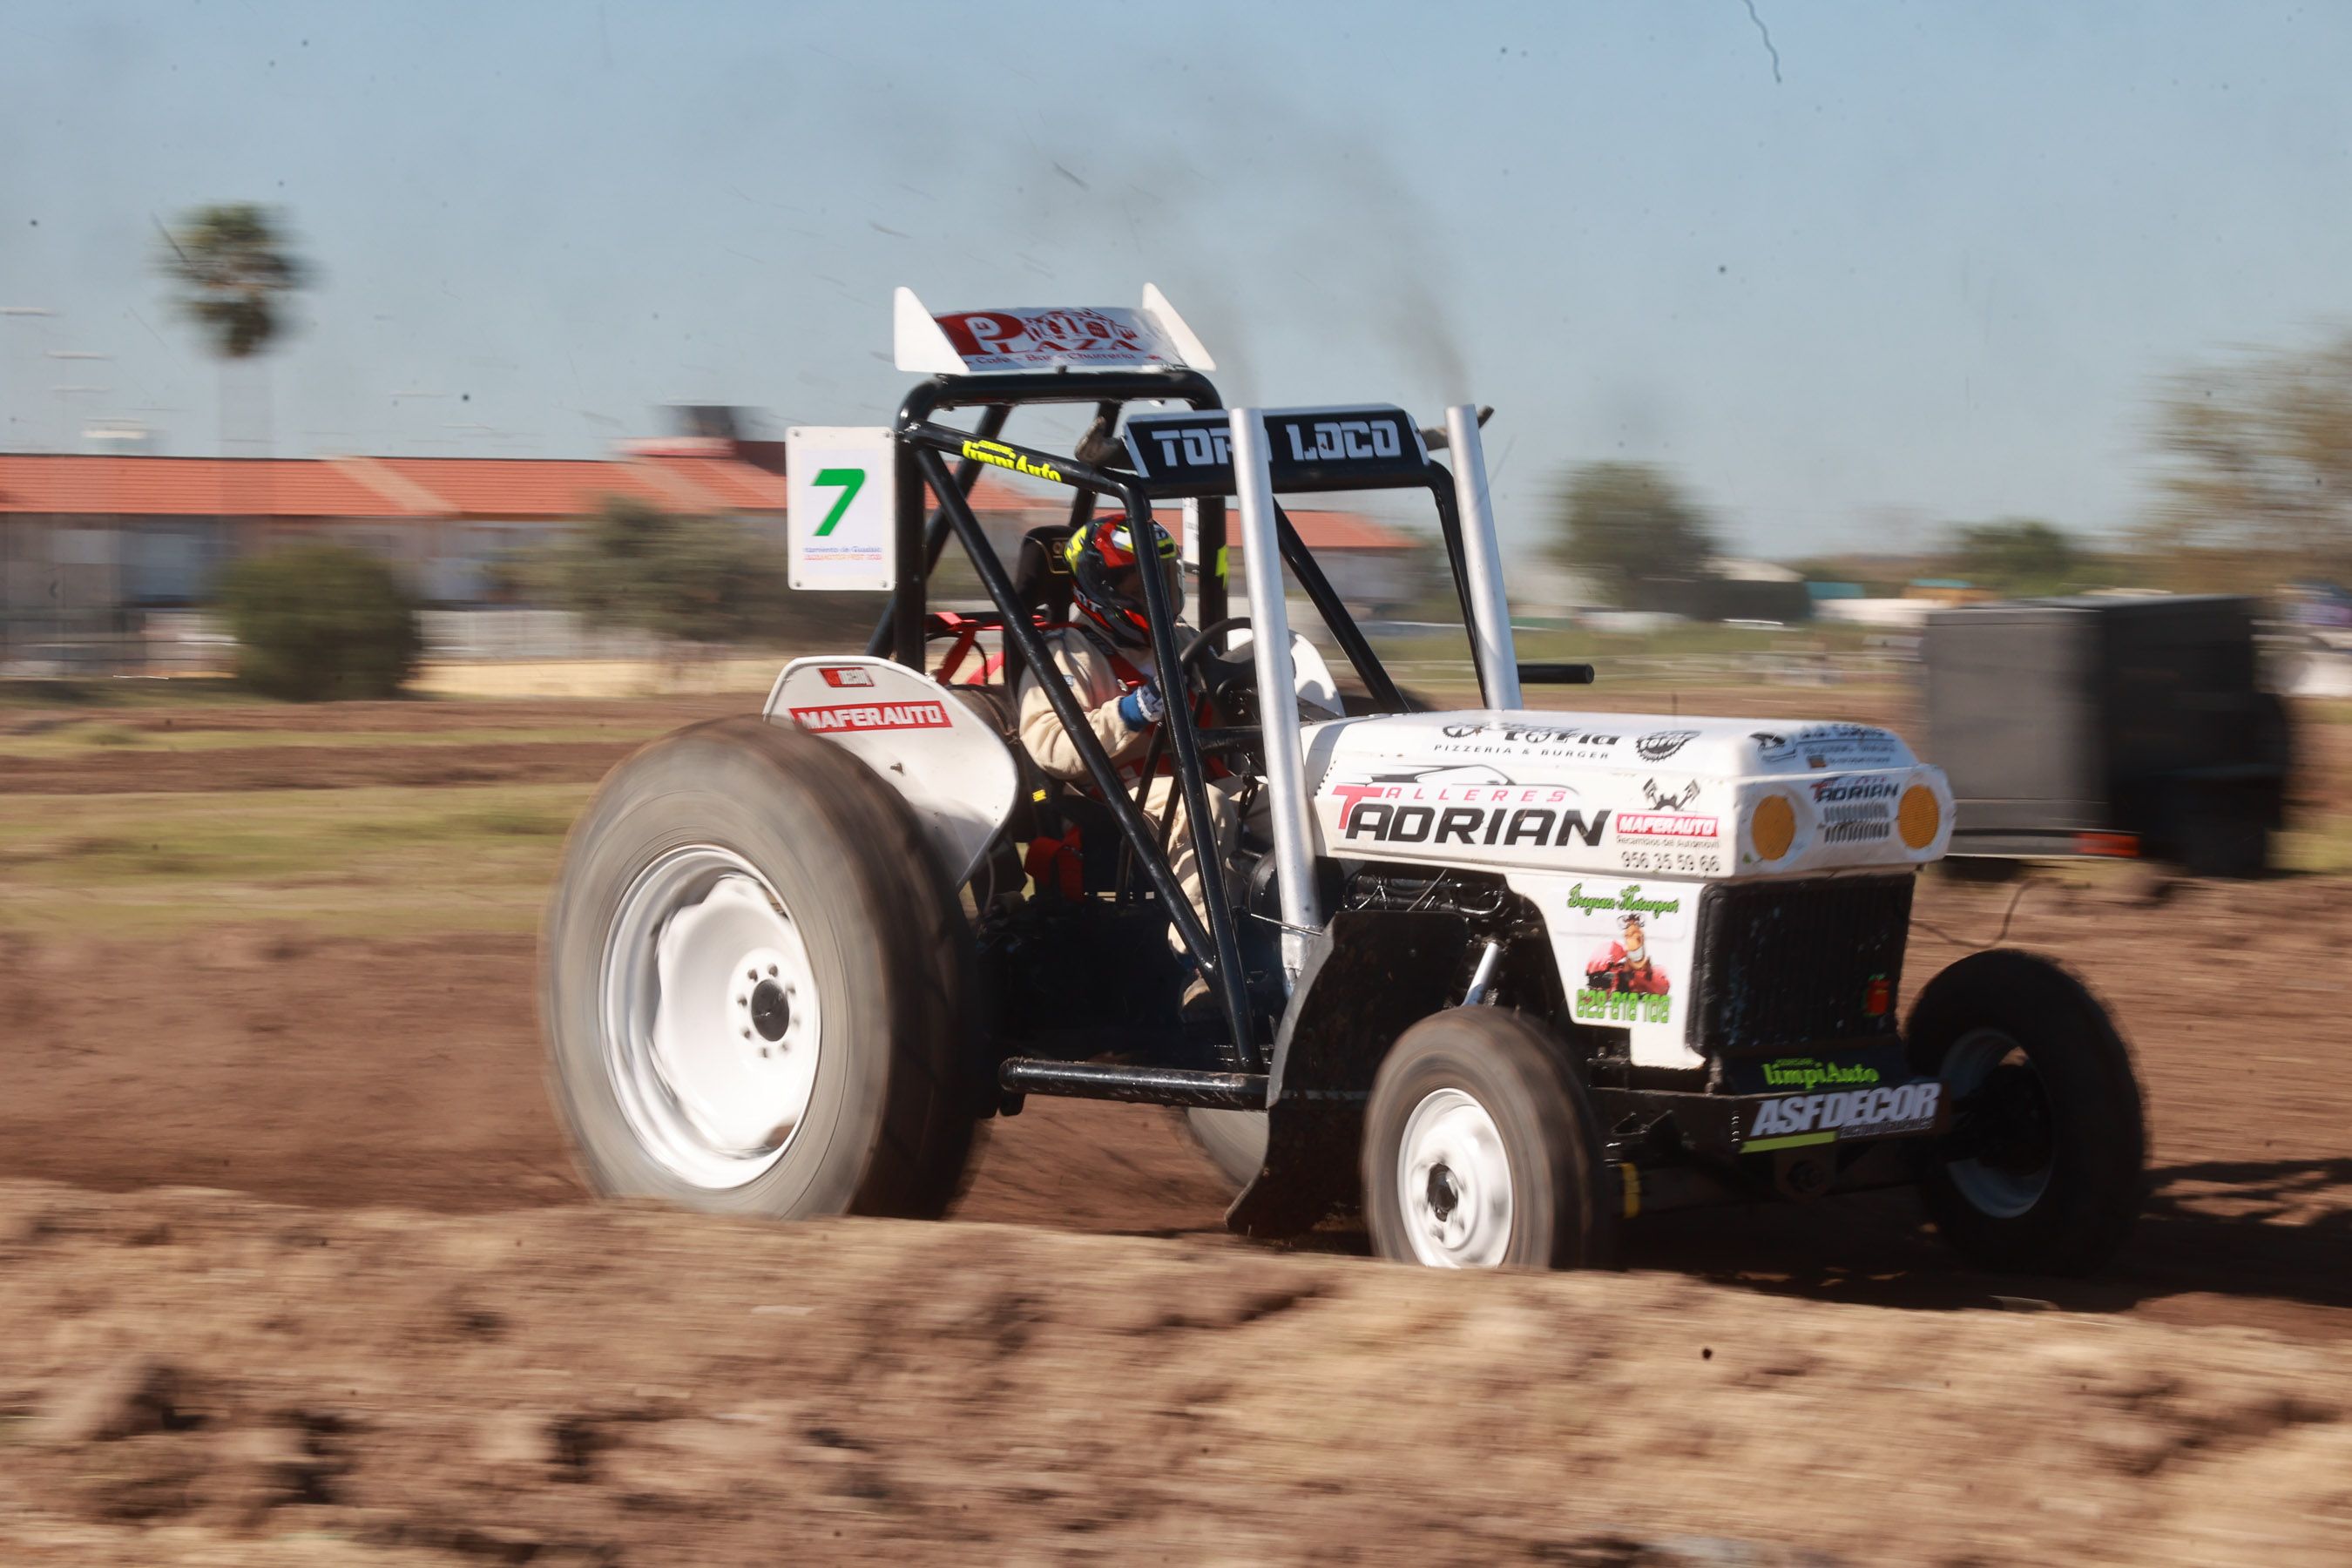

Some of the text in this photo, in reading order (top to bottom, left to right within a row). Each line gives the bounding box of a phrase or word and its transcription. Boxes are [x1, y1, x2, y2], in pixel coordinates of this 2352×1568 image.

[936, 312, 1142, 355] PLAZA
[1286, 420, 1402, 461] LOCO
[811, 468, 866, 537] 7
[799, 706, 943, 729] MAFERAUTO
[1434, 744, 1511, 754] PIZZERIA
[1541, 749, 1609, 760] BURGER
[1346, 802, 1612, 847] ADRIAN
[1619, 817, 1713, 835] MAFERAUTO
[1621, 850, 1720, 872] 956 35 59 66
[1749, 1083, 1942, 1137] ASFDECOR
